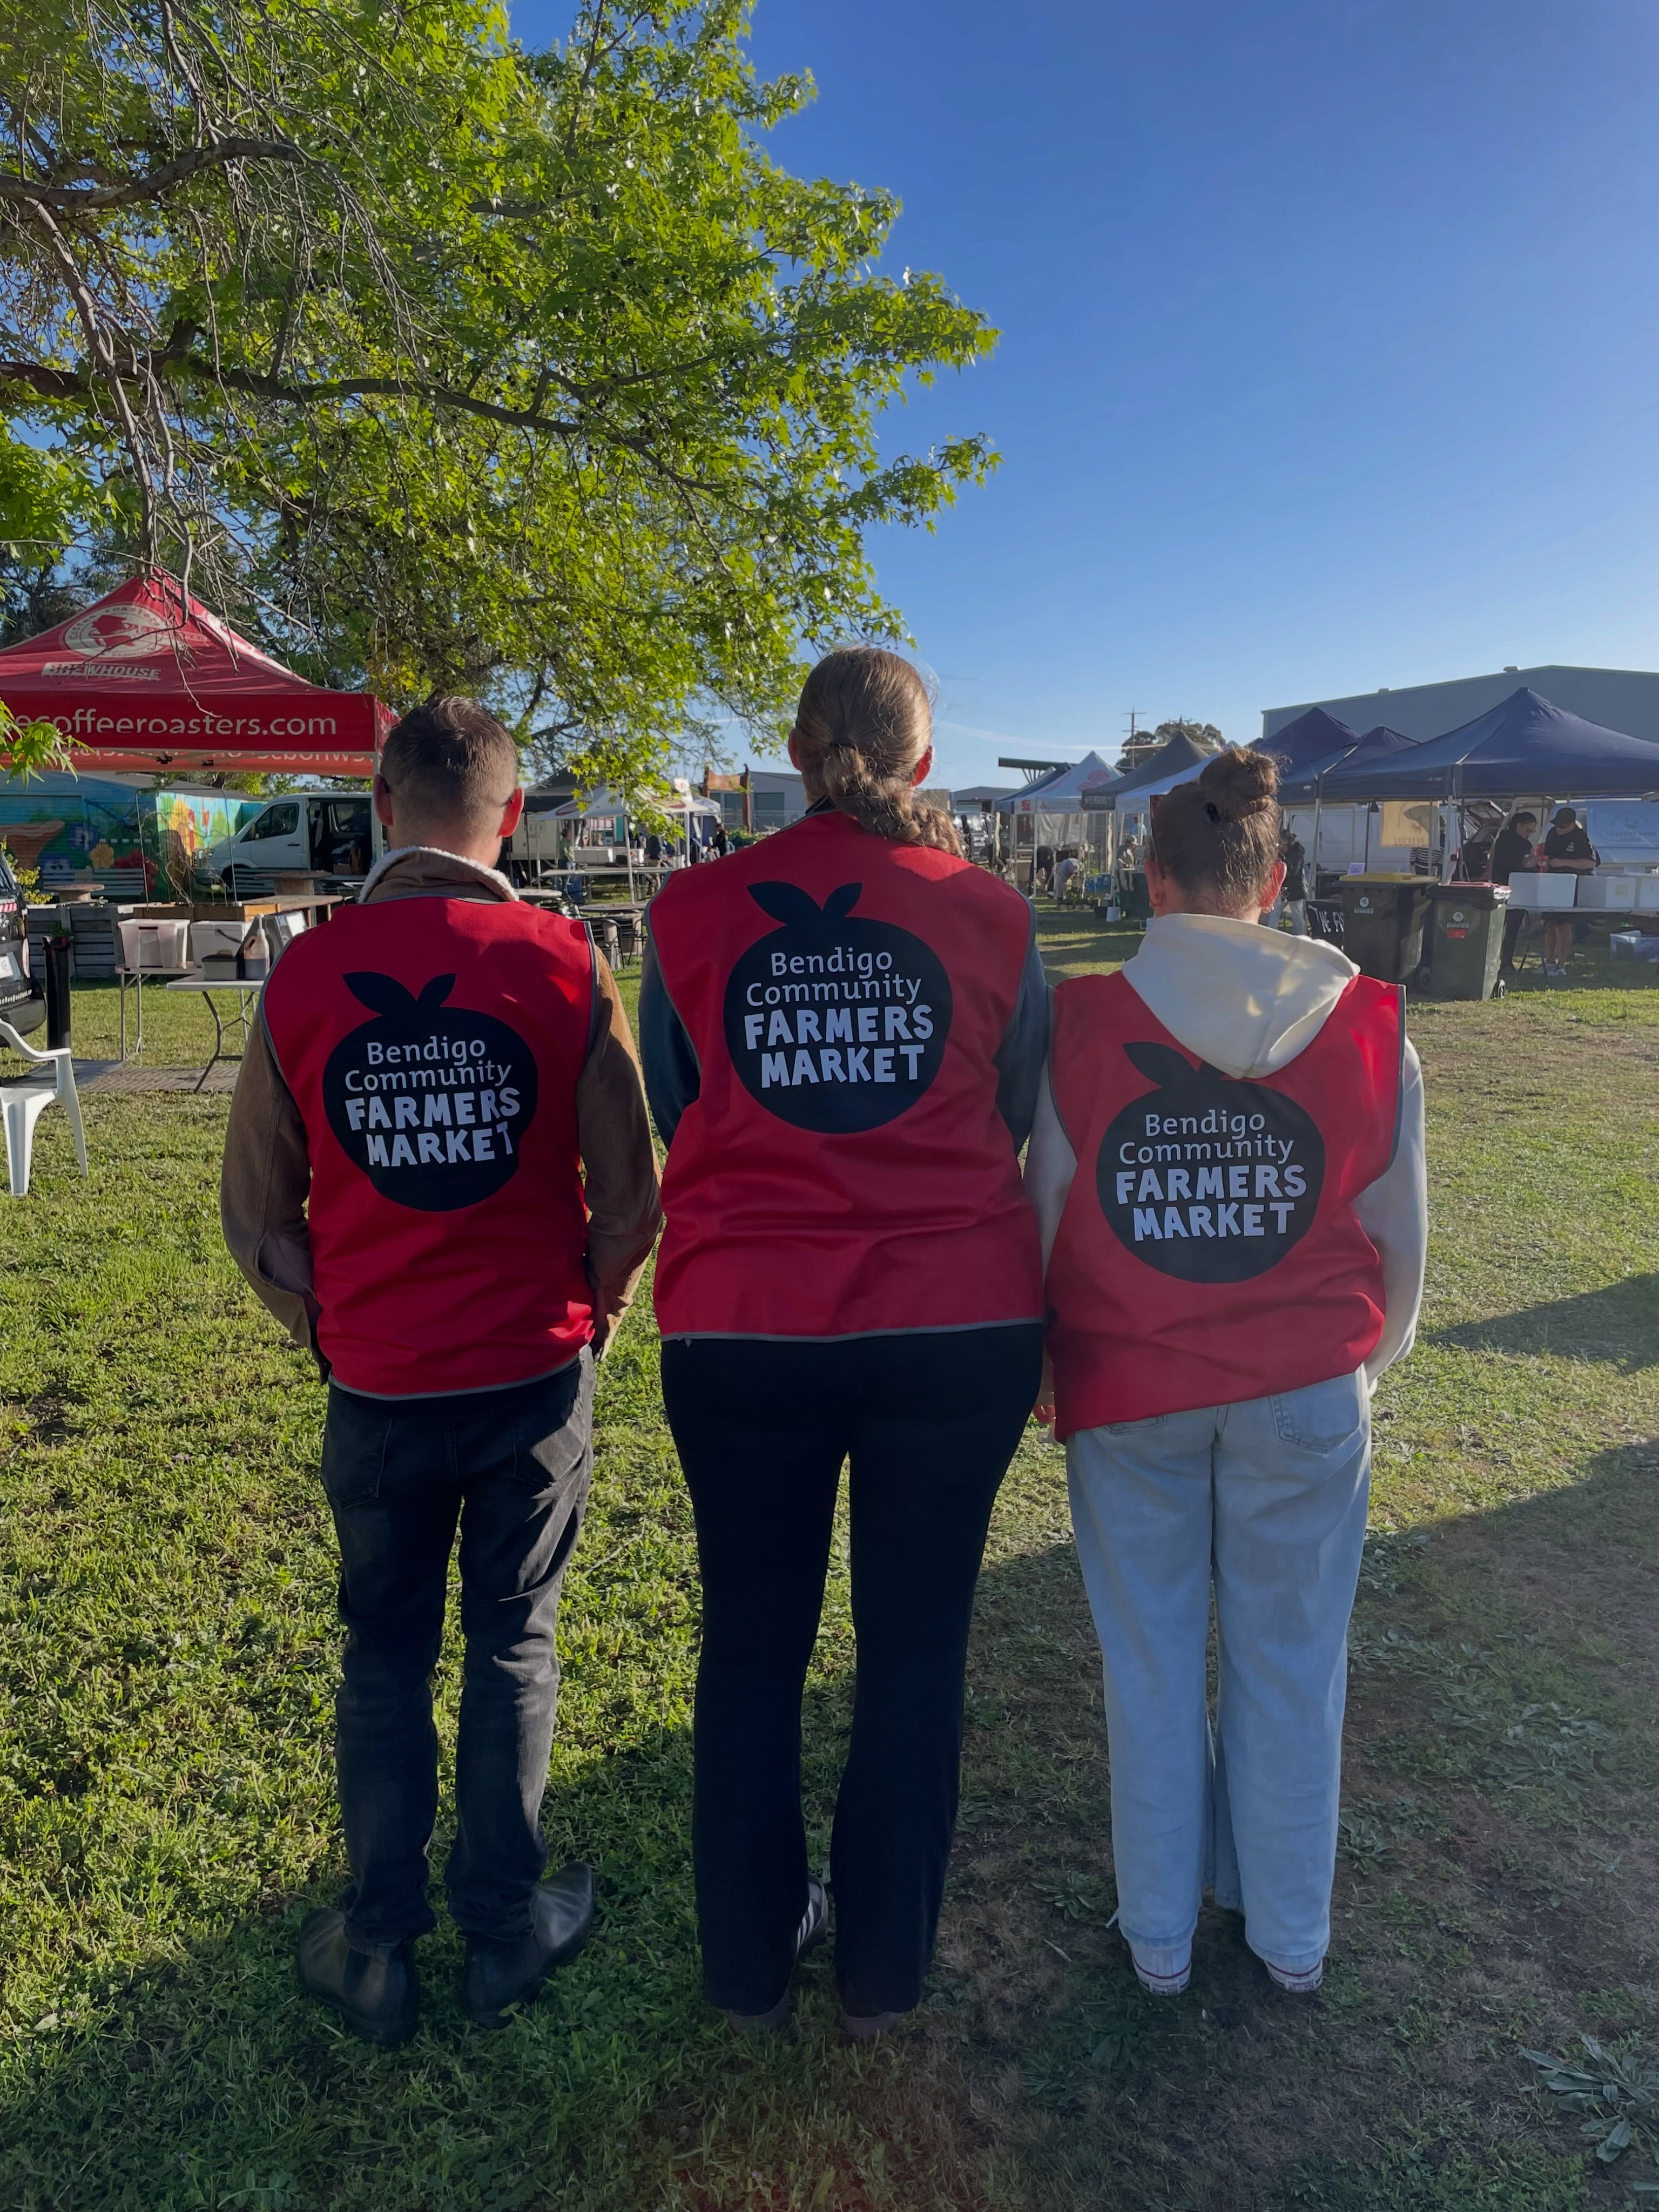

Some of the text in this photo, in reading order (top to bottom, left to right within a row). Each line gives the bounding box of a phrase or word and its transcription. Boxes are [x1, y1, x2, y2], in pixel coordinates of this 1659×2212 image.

[771, 947, 893, 979] Bendigo
[746, 974, 921, 1006] Community
[744, 1004, 933, 1050] FARMERS
[367, 1036, 485, 1065] Bendigo
[761, 1044, 925, 1088] MARKET
[345, 1060, 512, 1091] Community
[345, 1087, 520, 1130] FARMERS
[1145, 1109, 1265, 1139] Bendigo
[366, 1121, 513, 1167] MARKET
[1119, 1134, 1294, 1164] Community
[1116, 1165, 1307, 1204] FARMERS
[1133, 1202, 1294, 1241] MARKET
